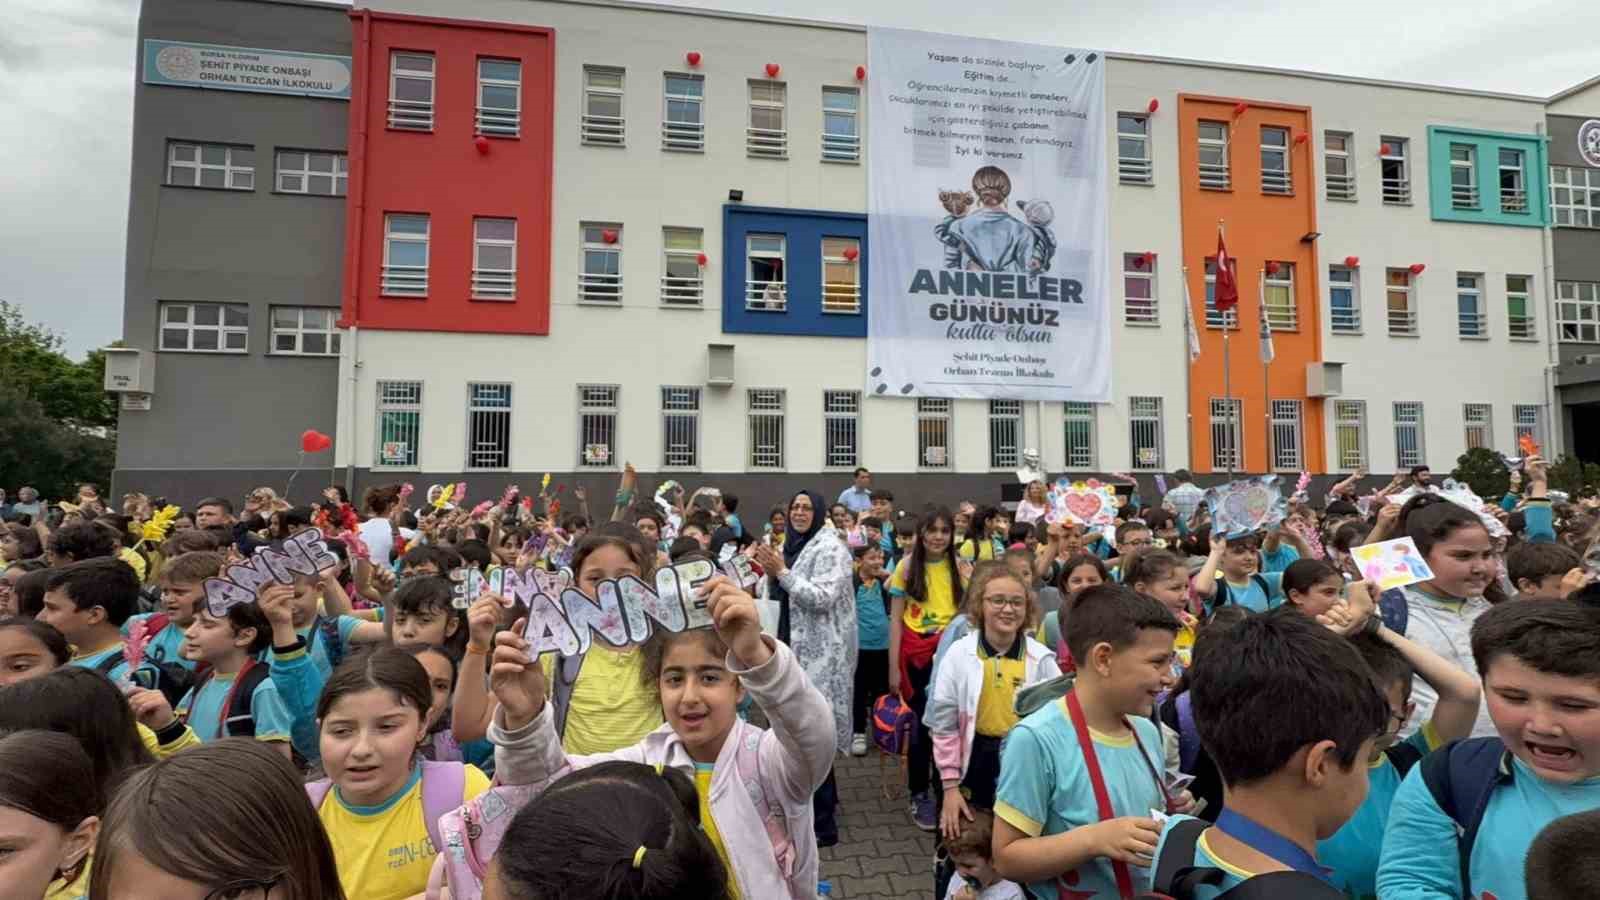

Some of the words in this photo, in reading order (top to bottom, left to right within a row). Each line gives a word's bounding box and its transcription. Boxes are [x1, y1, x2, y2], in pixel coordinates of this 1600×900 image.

[199, 71, 238, 83] ORHAN
[239, 74, 280, 87] TEZCAN
[282, 77, 333, 91] İLKOKULU
[200, 61, 231, 70] ŞEHİT
[272, 66, 312, 78] ONBAŞI
[908, 268, 1084, 304] ANNELER
[929, 298, 1060, 327] GÜNÜNÜZ
[946, 322, 996, 342] kutlu
[1006, 324, 1053, 345] olsun
[202, 527, 338, 619] ANNE
[521, 558, 716, 665] ANNE
